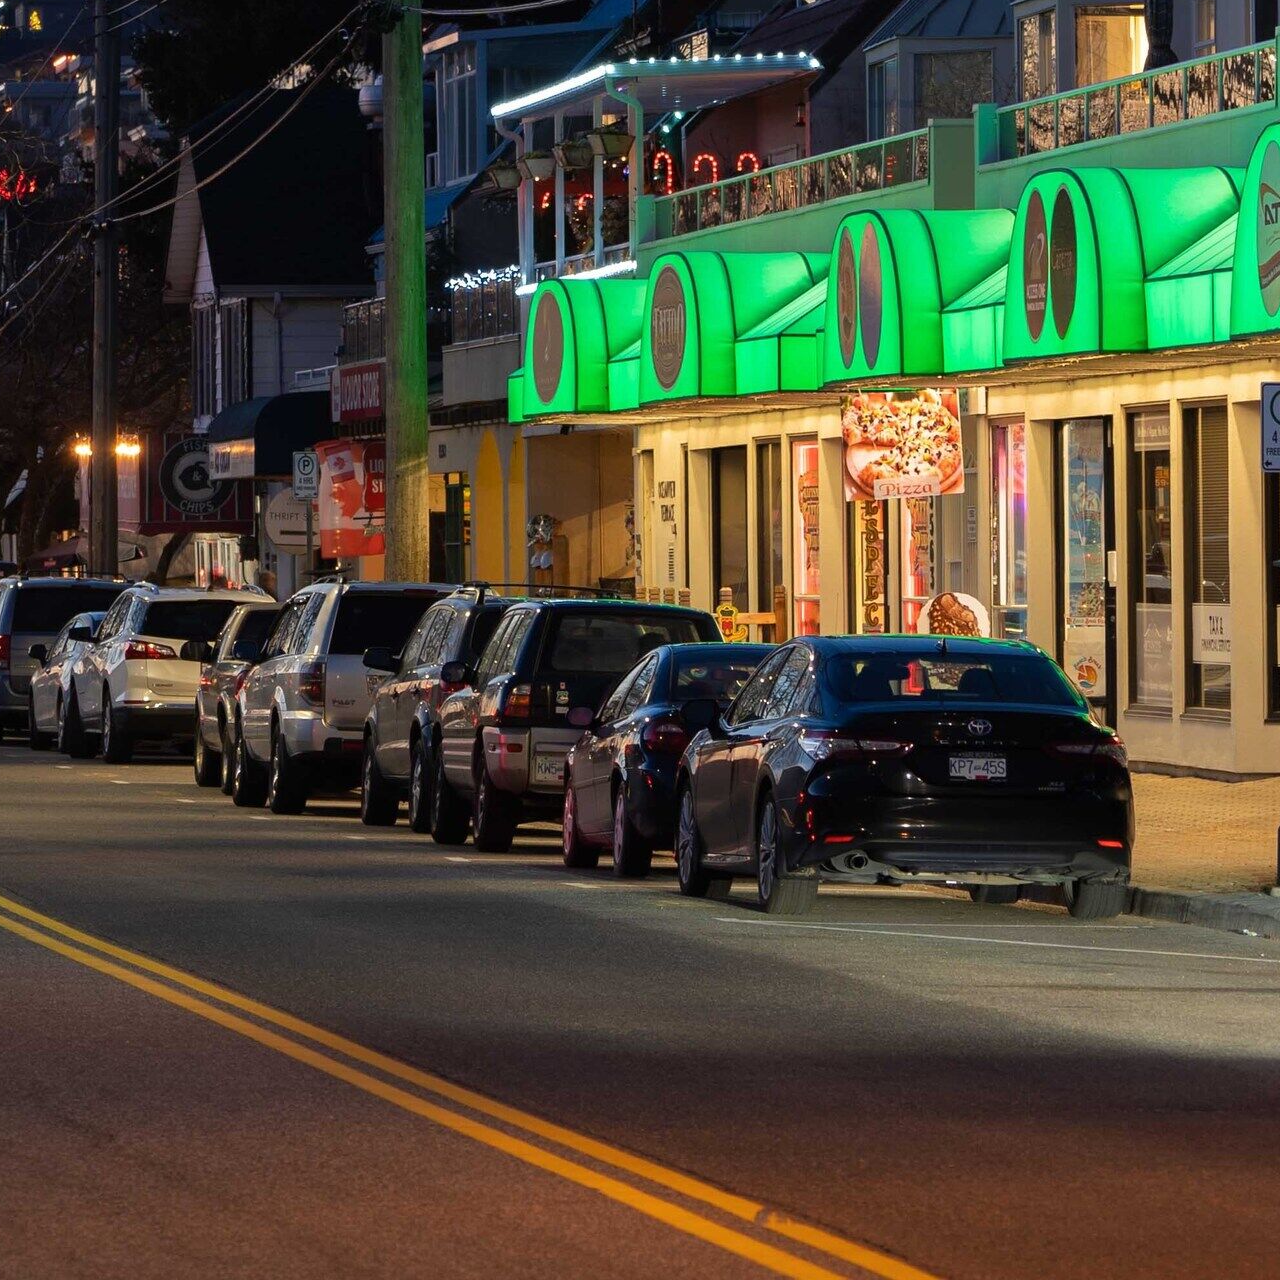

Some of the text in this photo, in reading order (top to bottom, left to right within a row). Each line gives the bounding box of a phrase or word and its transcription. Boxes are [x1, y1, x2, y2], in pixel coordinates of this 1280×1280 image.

[1272, 430, 1278, 443] 4
[1266, 447, 1280, 456] FREE
[302, 459, 311, 472] P
[878, 482, 933, 497] Pizza
[179, 501, 215, 514] CHIPS
[269, 511, 300, 521] THRIFT
[950, 759, 1006, 775] KP7 45S
